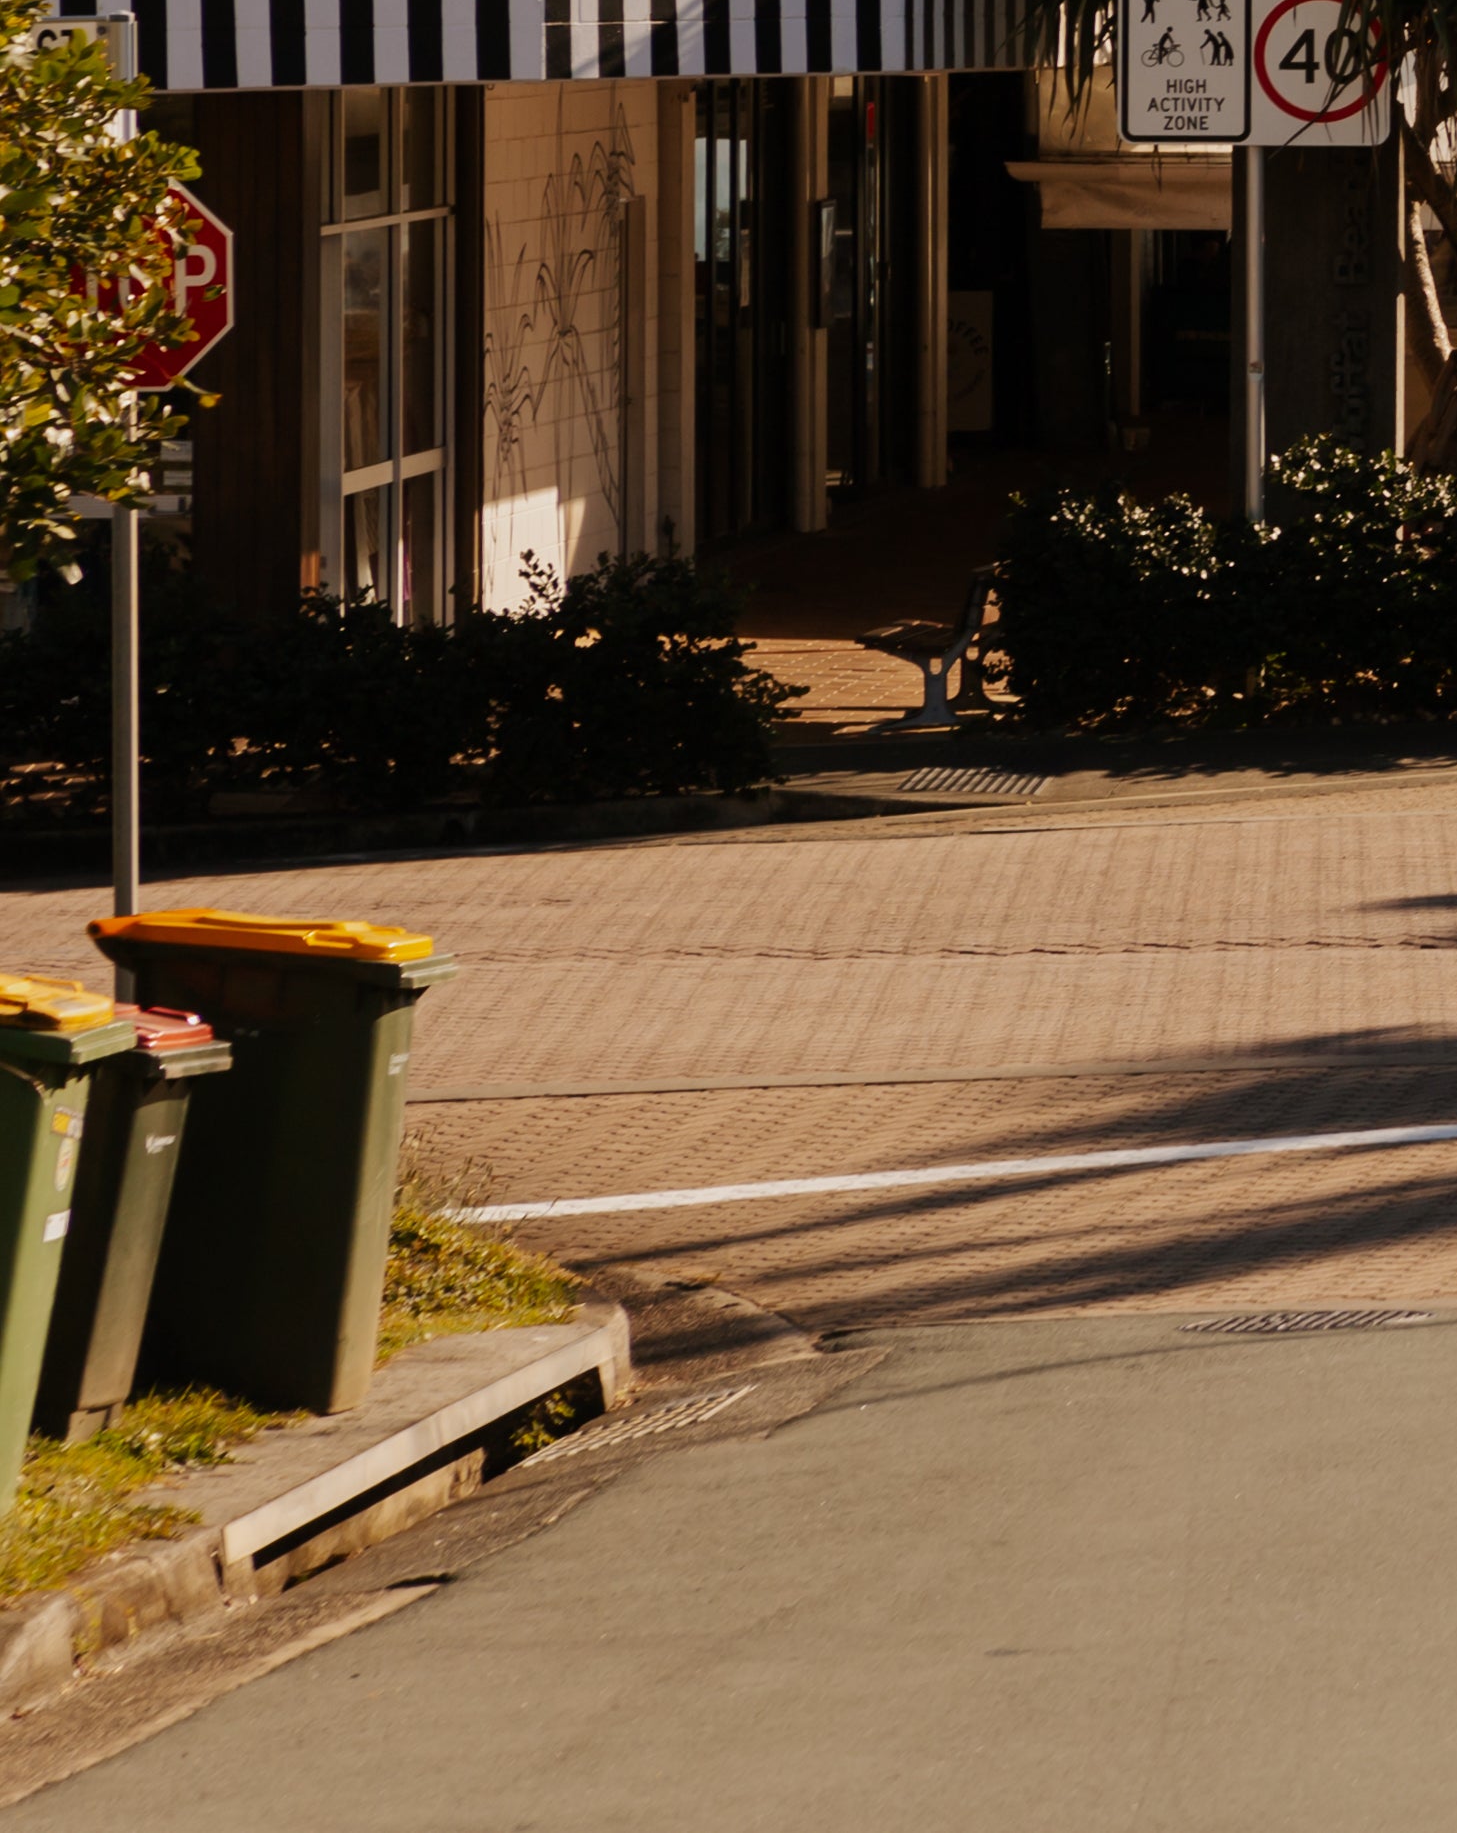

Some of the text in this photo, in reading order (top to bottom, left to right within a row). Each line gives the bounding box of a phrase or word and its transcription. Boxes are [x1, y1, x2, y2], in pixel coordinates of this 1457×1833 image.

[1278, 28, 1361, 85] 40
[1165, 78, 1207, 94] HIGH
[1146, 96, 1226, 113] ACTIVITY
[1163, 115, 1210, 131] ZONE
